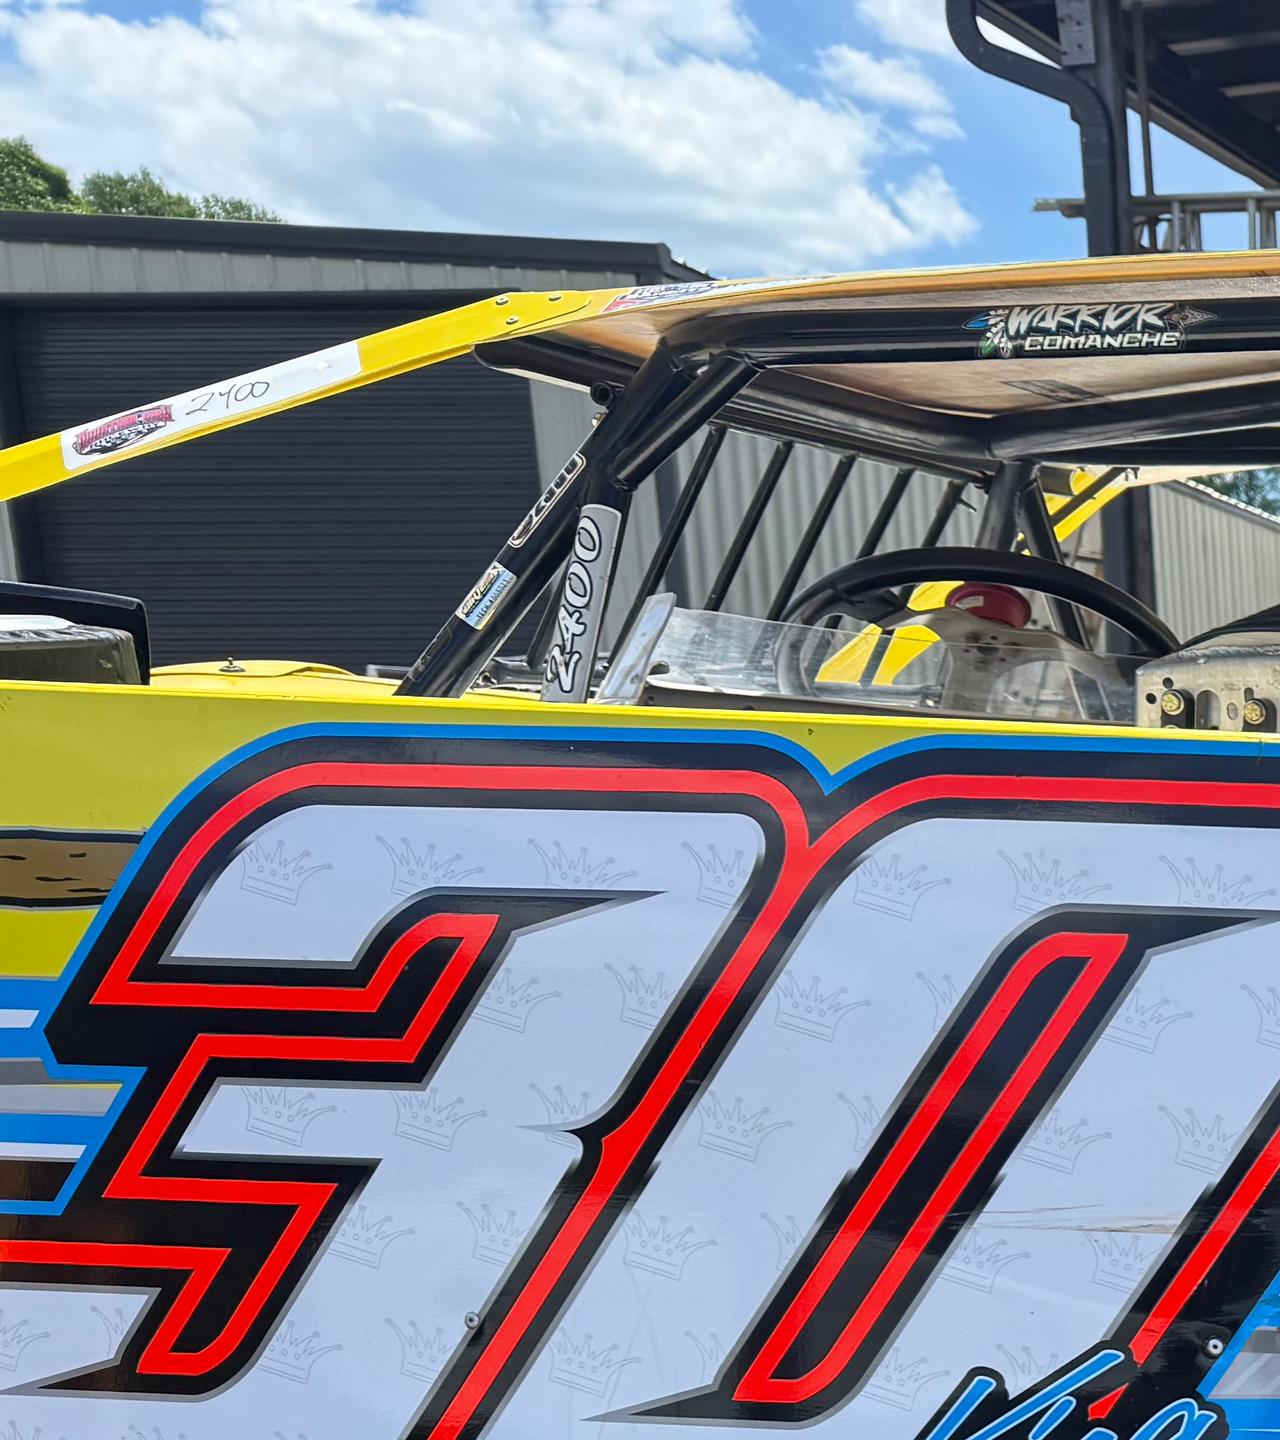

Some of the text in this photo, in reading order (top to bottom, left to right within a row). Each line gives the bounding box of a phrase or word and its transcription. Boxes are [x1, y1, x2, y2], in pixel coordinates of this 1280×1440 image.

[1007, 302, 1177, 337] WARRIOR
[1024, 331, 1181, 351] COMANCHE
[545, 515, 602, 694] 2400
